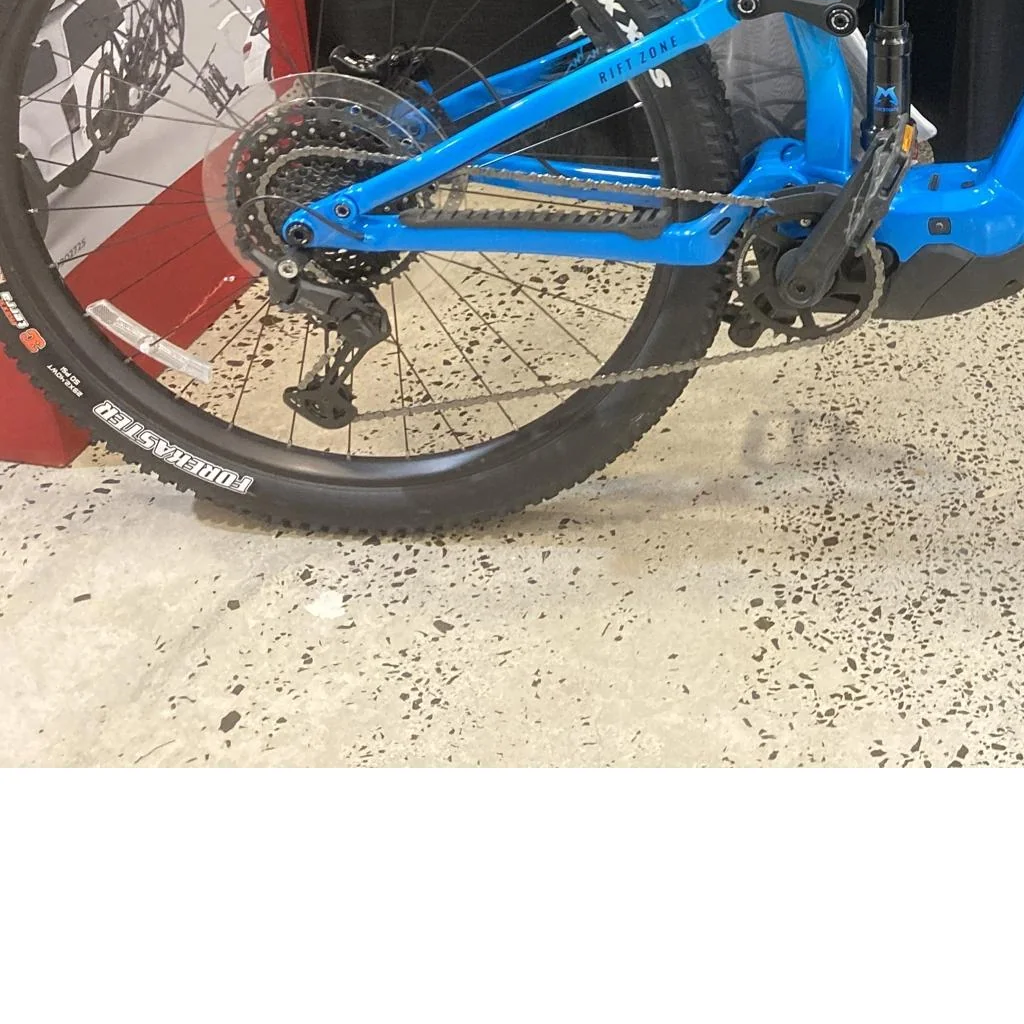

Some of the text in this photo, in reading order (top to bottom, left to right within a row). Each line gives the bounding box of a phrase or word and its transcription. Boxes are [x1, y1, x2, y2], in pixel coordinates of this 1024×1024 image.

[598, 35, 678, 84] RIFT ZONE
[92, 399, 254, 495] FOREKASTER
